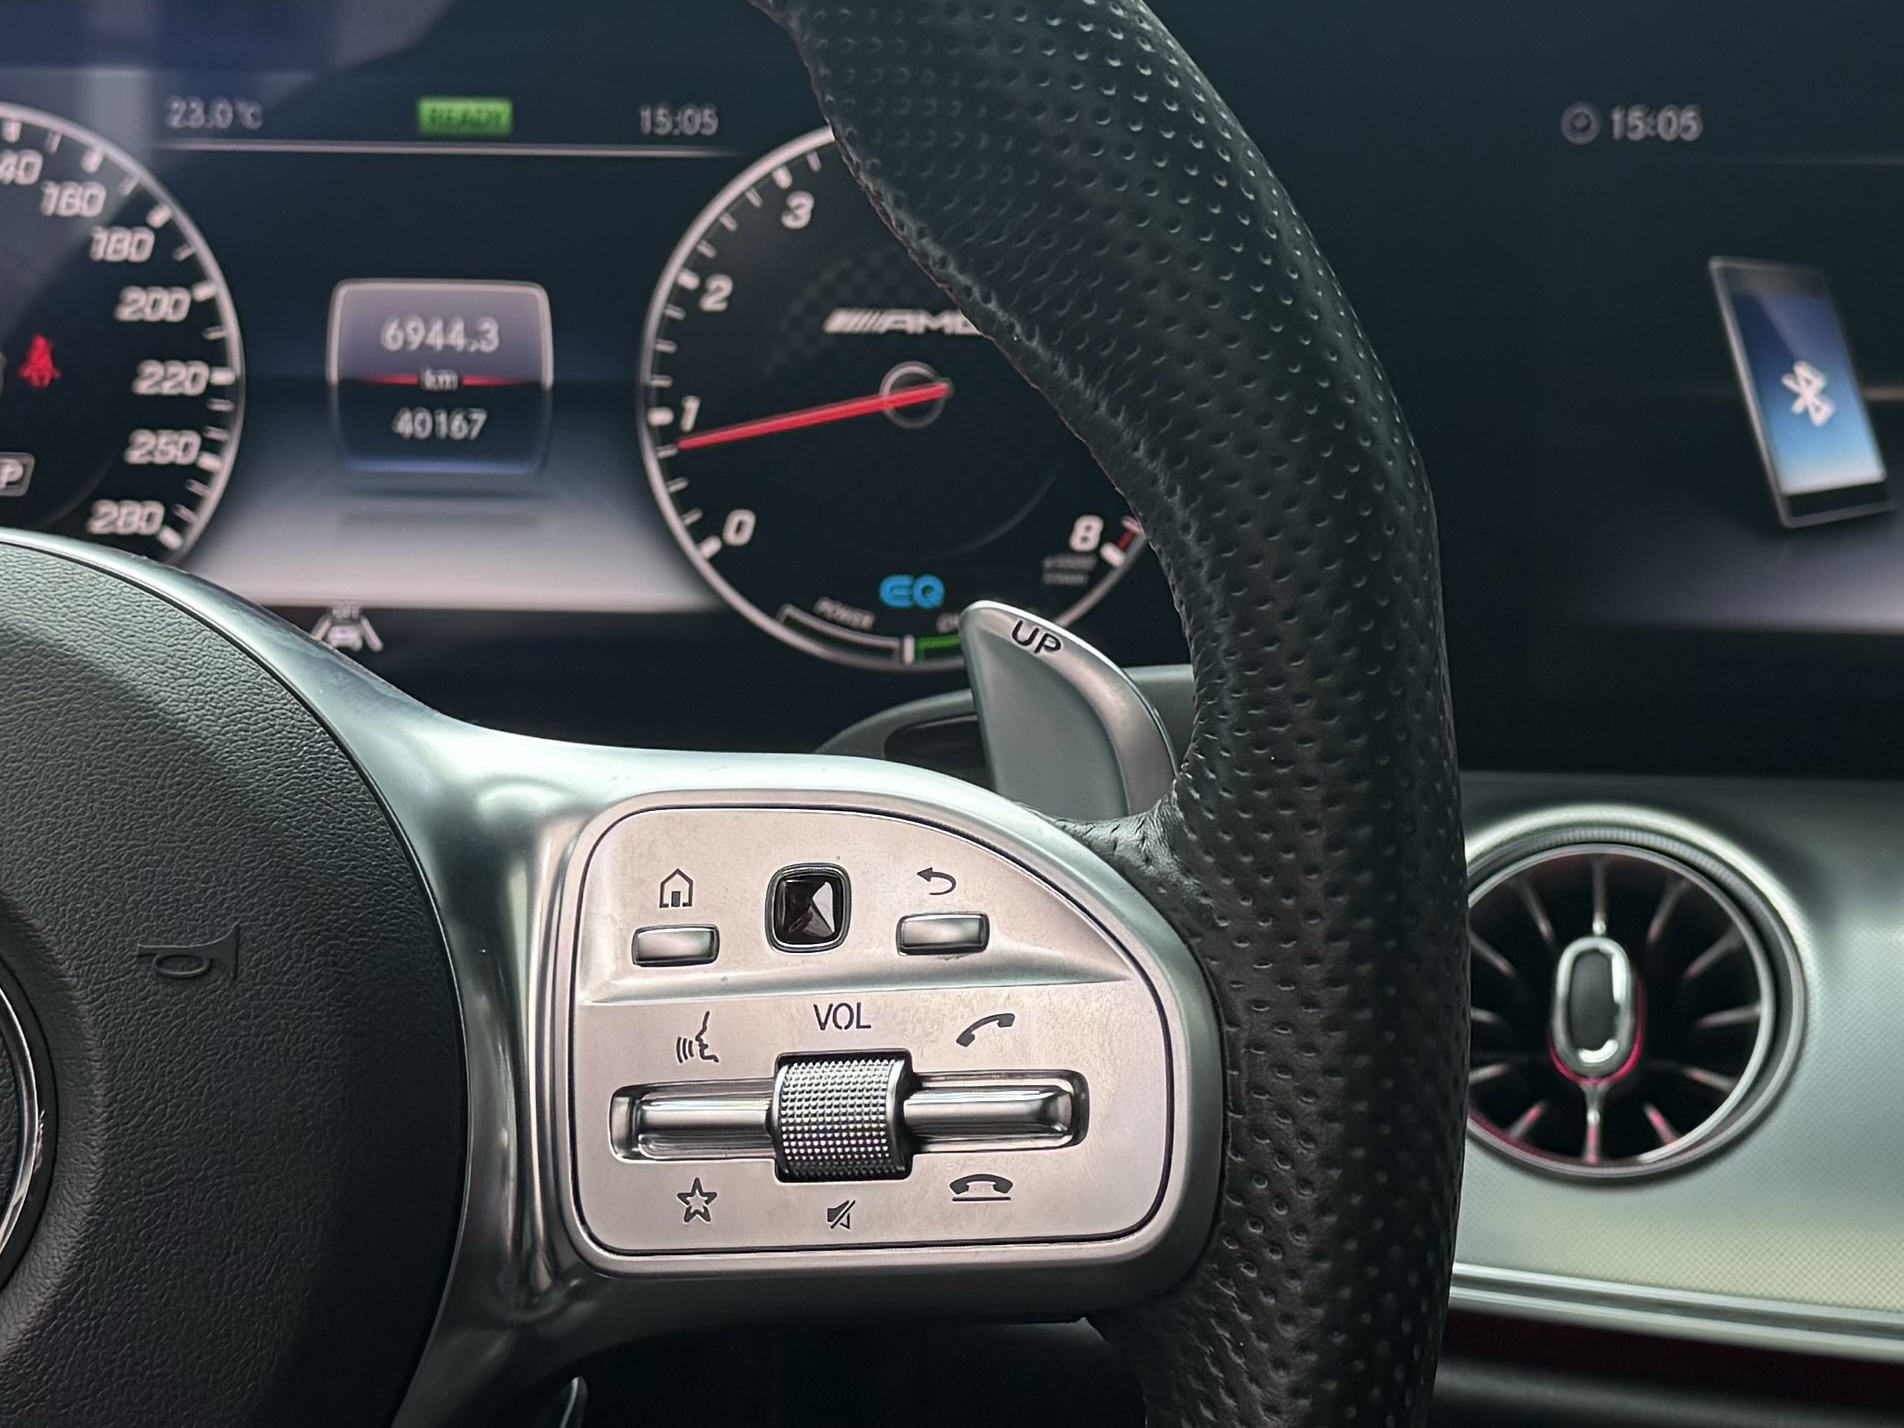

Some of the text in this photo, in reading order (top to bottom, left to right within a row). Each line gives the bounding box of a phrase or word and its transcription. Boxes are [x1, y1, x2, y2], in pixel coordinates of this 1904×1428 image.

[639, 103, 720, 136] 15:05
[1610, 103, 1704, 142] 15:05
[40, 180, 106, 218] 160
[781, 191, 815, 229] 3
[88, 226, 155, 263] 180
[114, 287, 191, 323] 200
[700, 275, 734, 311] 2
[380, 315, 499, 353] 6944.3
[131, 360, 210, 396] 220
[420, 367, 459, 391] km
[392, 406, 488, 440] 40167
[680, 395, 700, 432] 1
[124, 429, 201, 466] 250
[722, 508, 757, 546] 0
[1070, 514, 1104, 552] 8
[879, 574, 945, 609] EQ
[1010, 619, 1063, 656] UP
[812, 1002, 872, 1032] VOL
